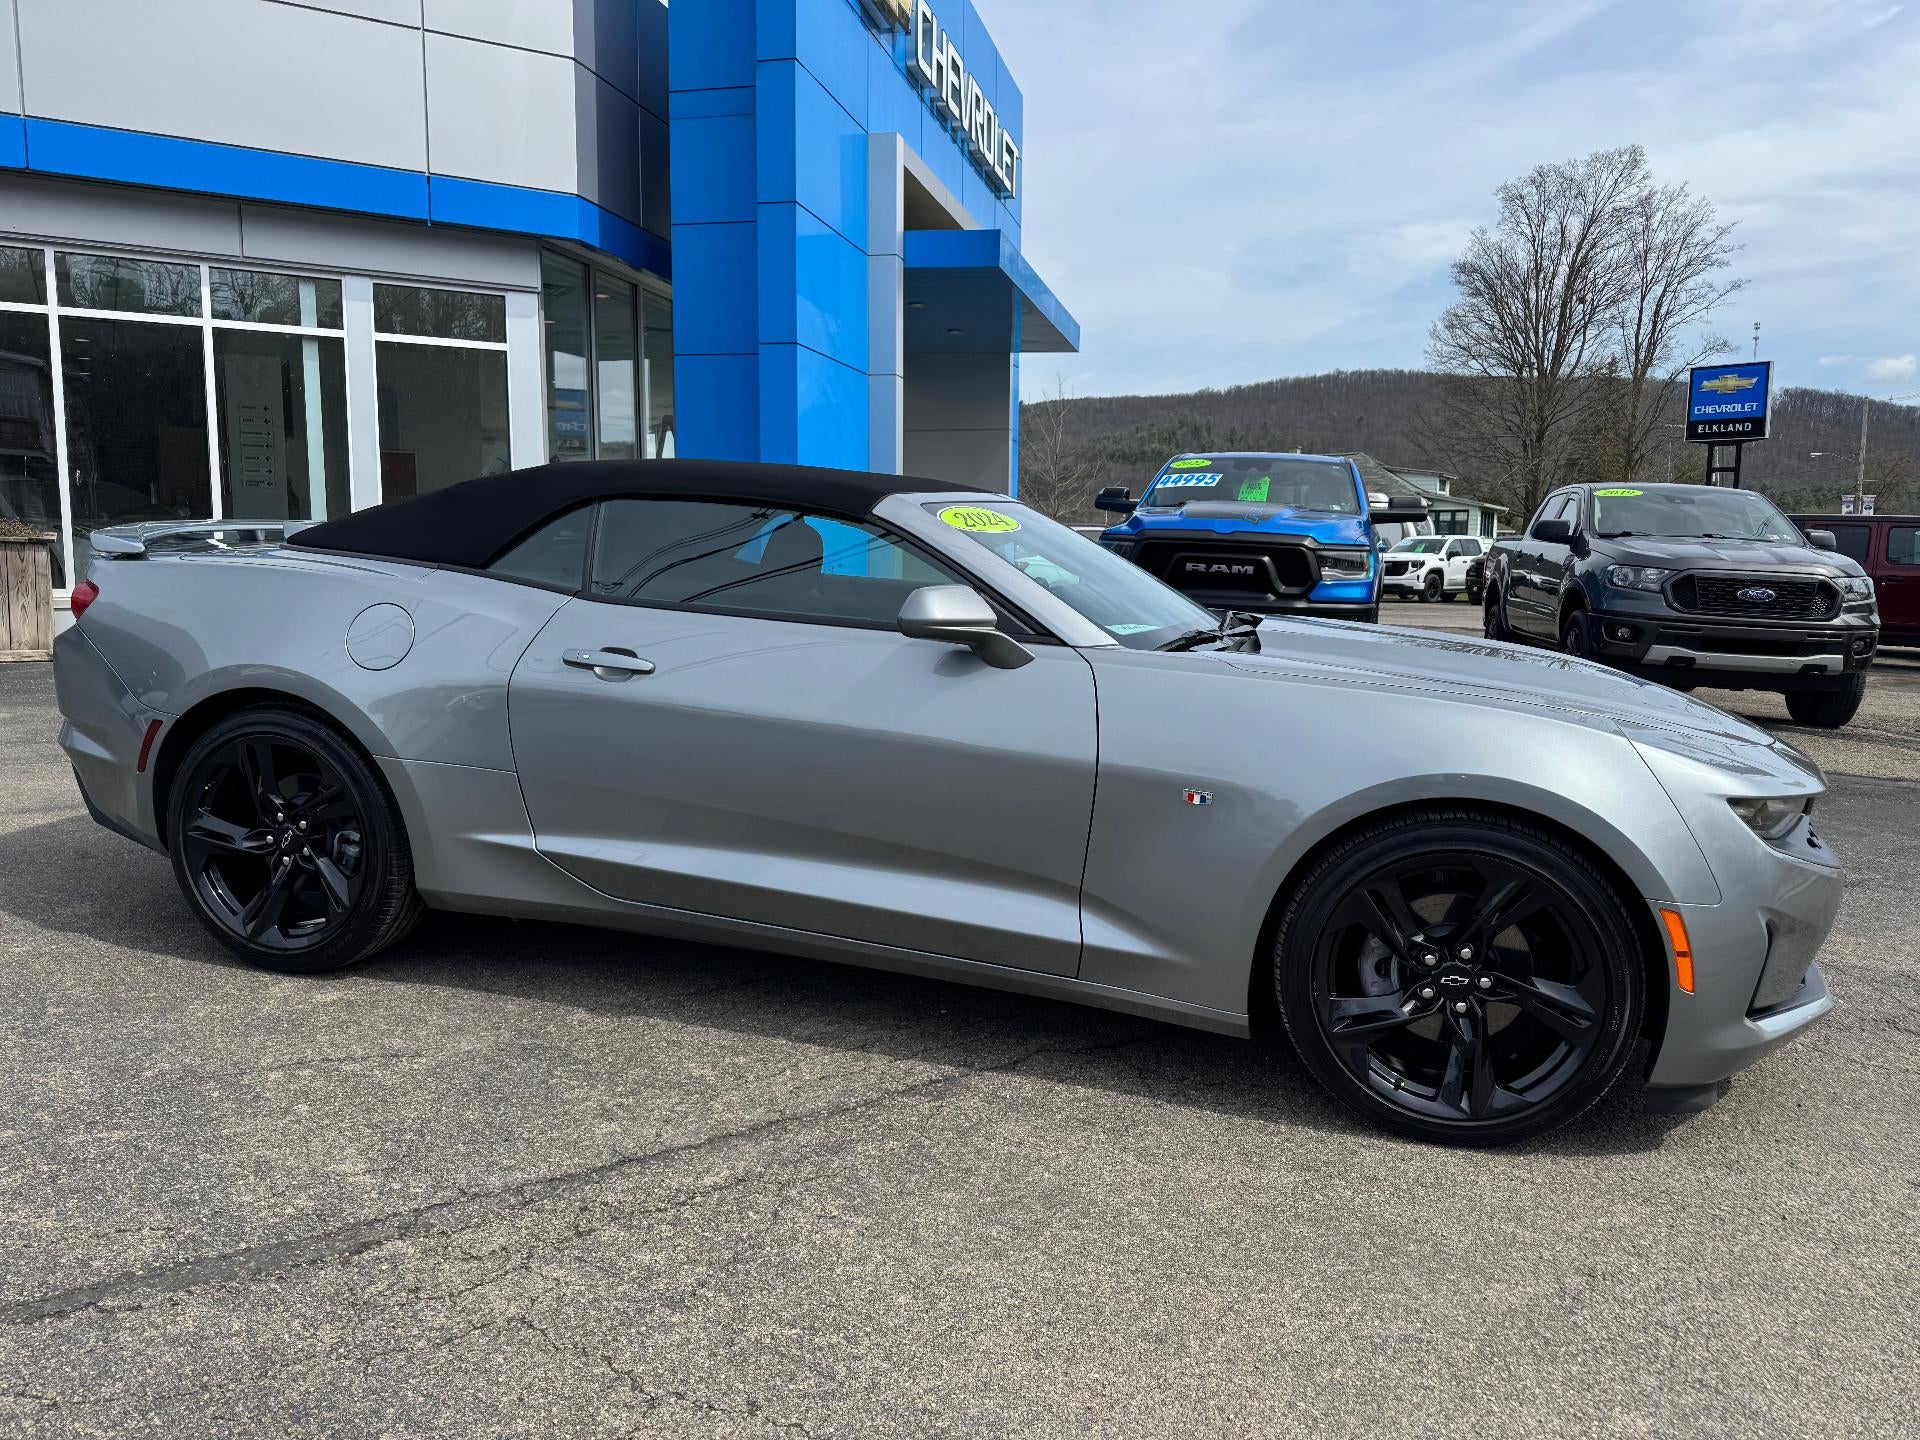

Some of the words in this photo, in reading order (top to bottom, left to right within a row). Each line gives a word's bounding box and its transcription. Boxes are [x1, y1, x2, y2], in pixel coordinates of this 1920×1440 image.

[916, 0, 1019, 199] CHEVROLET
[1694, 402, 1759, 415] CHEVROLET
[1697, 422, 1752, 434] ELKLAND
[1160, 474, 1220, 486] 44995
[953, 512, 1011, 527] 2024
[1185, 562, 1254, 575] RAM
